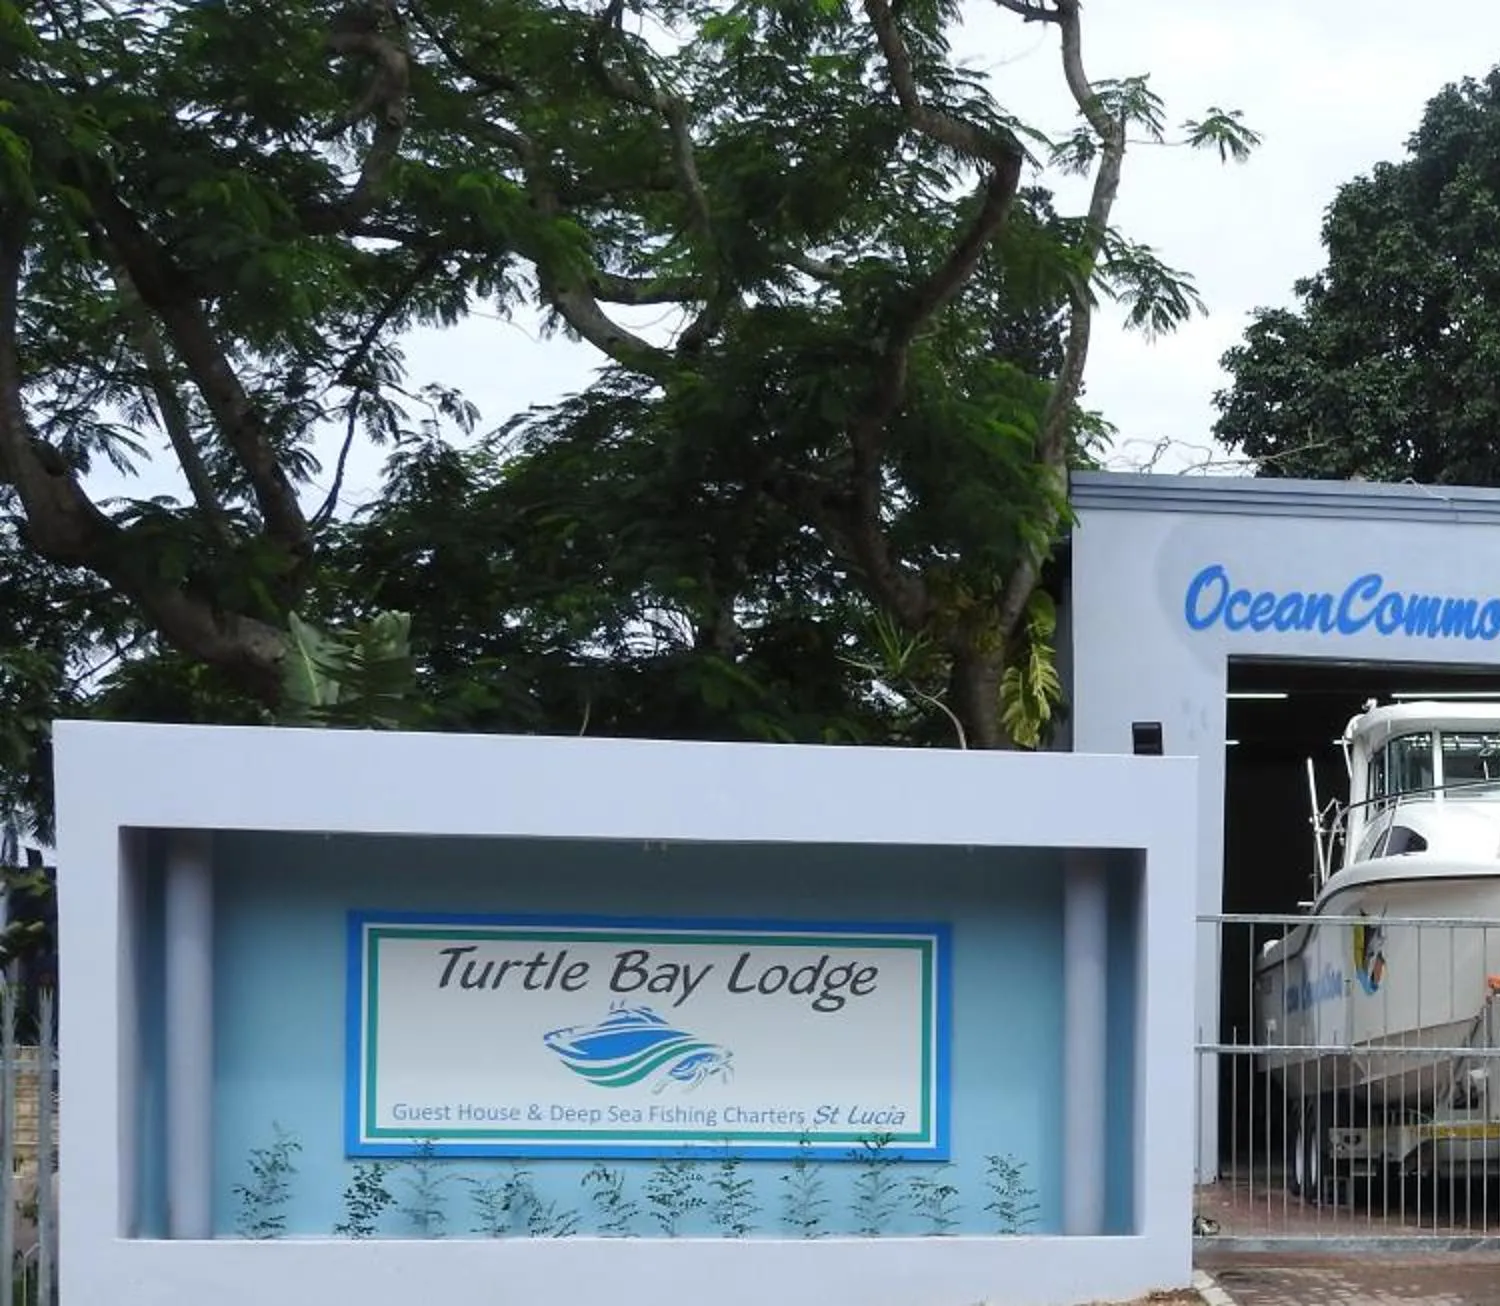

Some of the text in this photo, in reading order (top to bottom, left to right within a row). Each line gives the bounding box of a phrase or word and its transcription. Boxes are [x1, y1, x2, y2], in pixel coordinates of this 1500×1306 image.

[436, 945, 880, 1012] Turtle Bay Lodge
[392, 1103, 906, 1126] Guest House & Deep Sea Fishing Charters St Lucia
